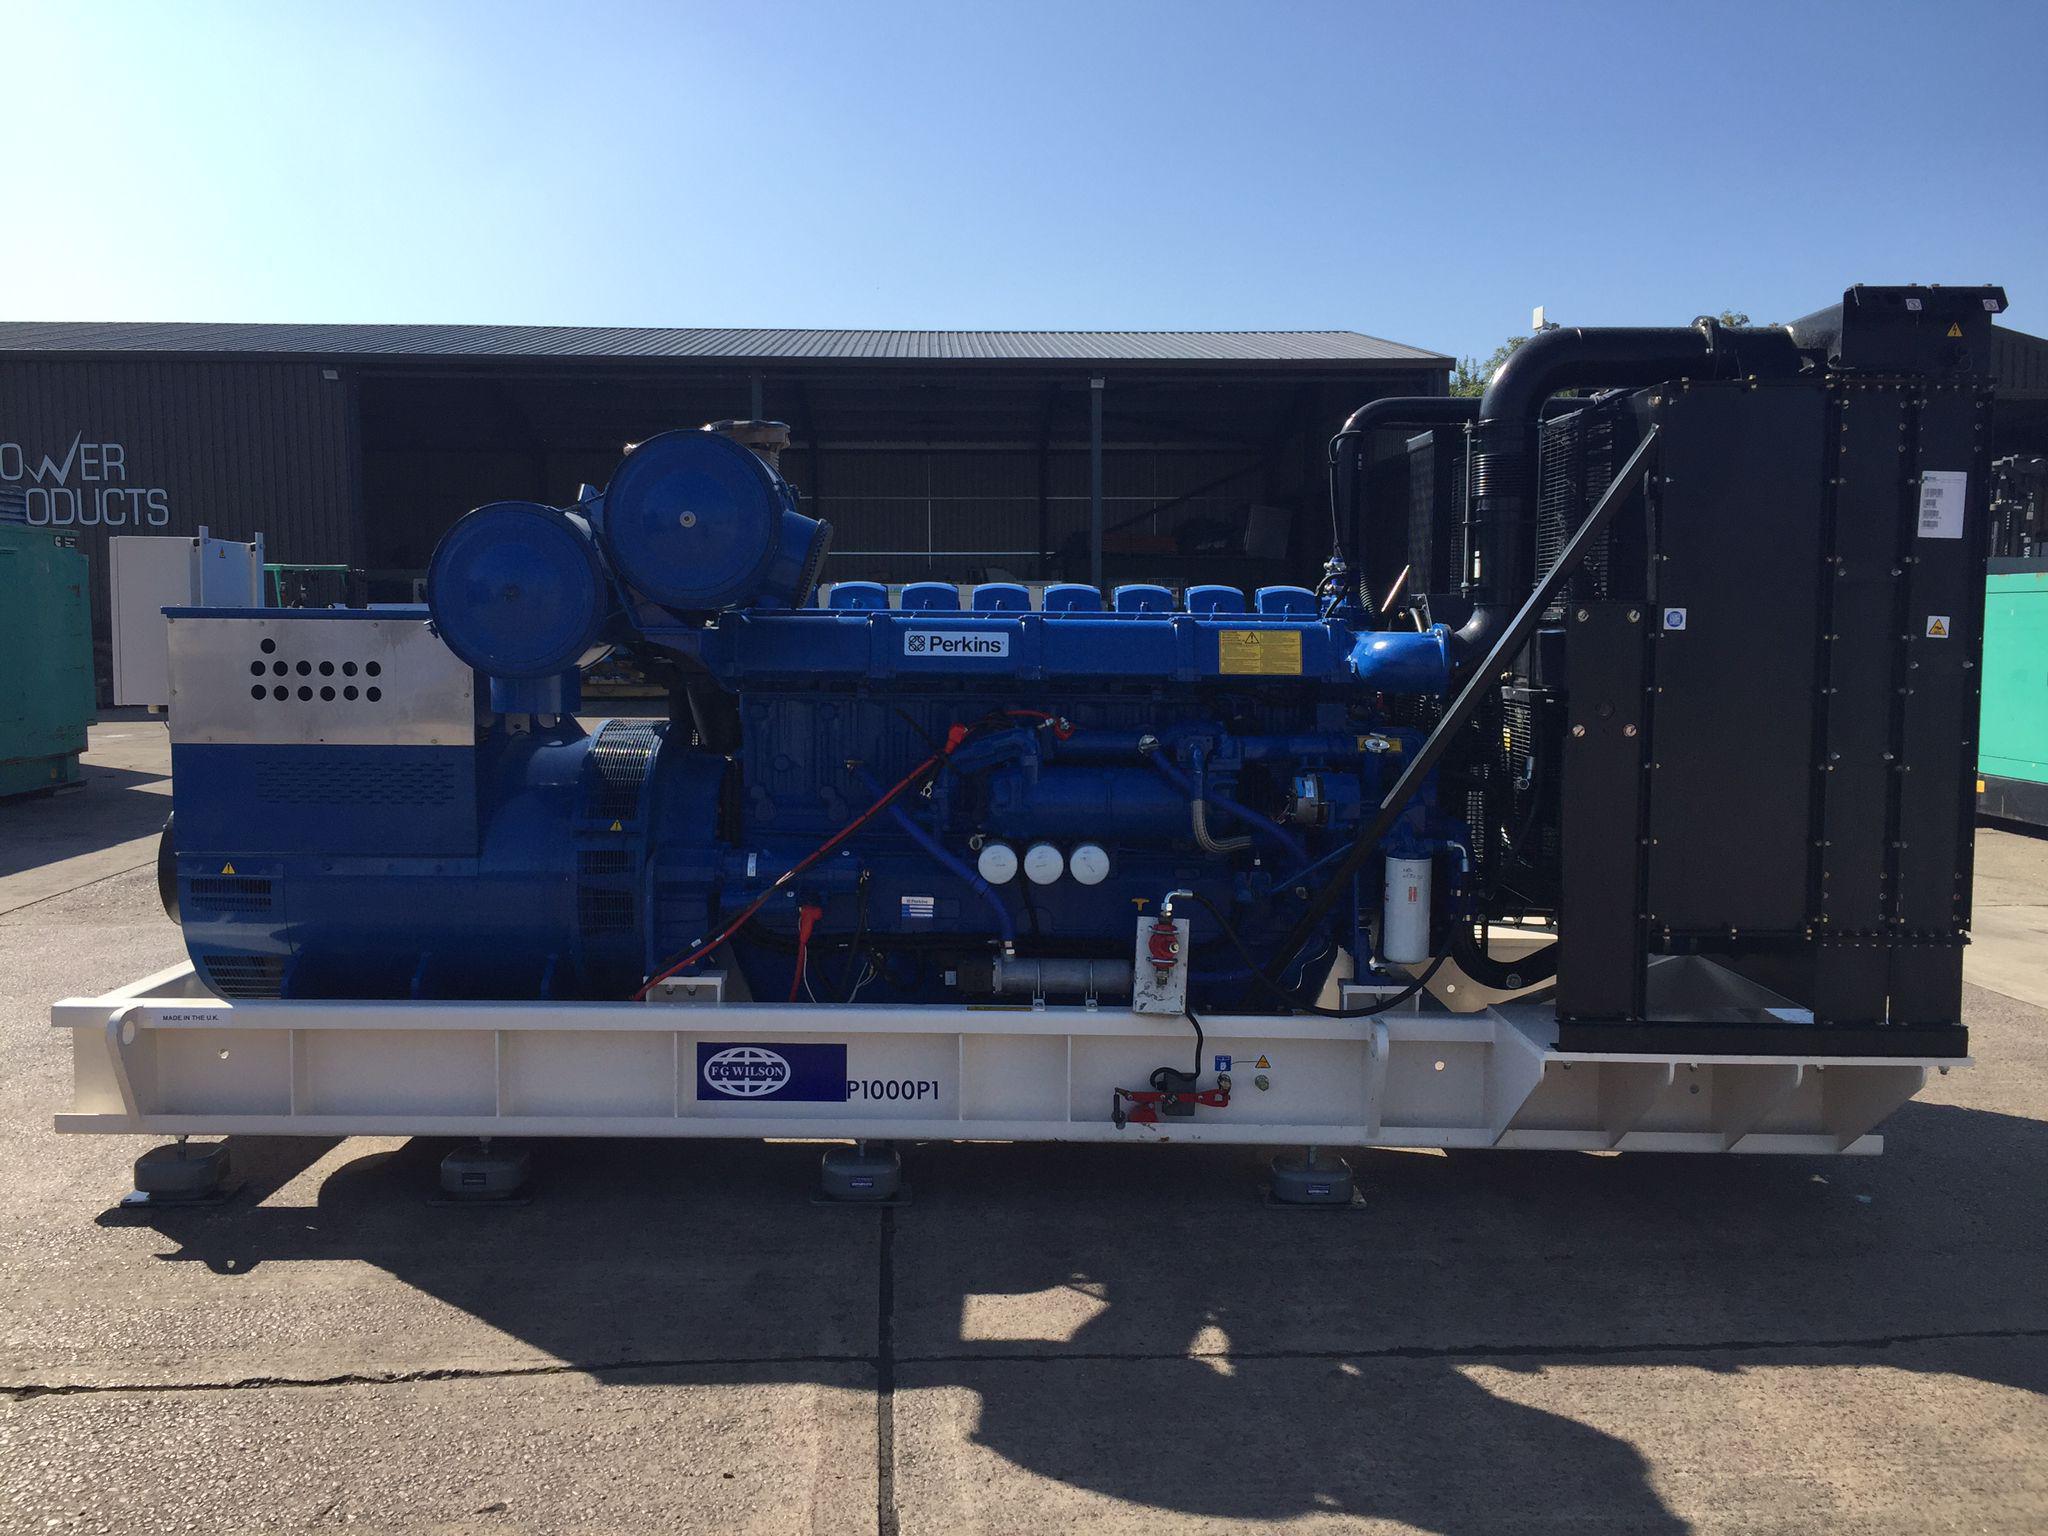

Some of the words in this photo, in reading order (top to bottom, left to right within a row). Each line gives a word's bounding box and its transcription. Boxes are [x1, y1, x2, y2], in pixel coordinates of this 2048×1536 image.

[929, 635, 1002, 653] Perkins
[162, 1014, 182, 1022] MADE
[732, 1066, 784, 1077] WILSON
[847, 1079, 939, 1100] P1000P1
